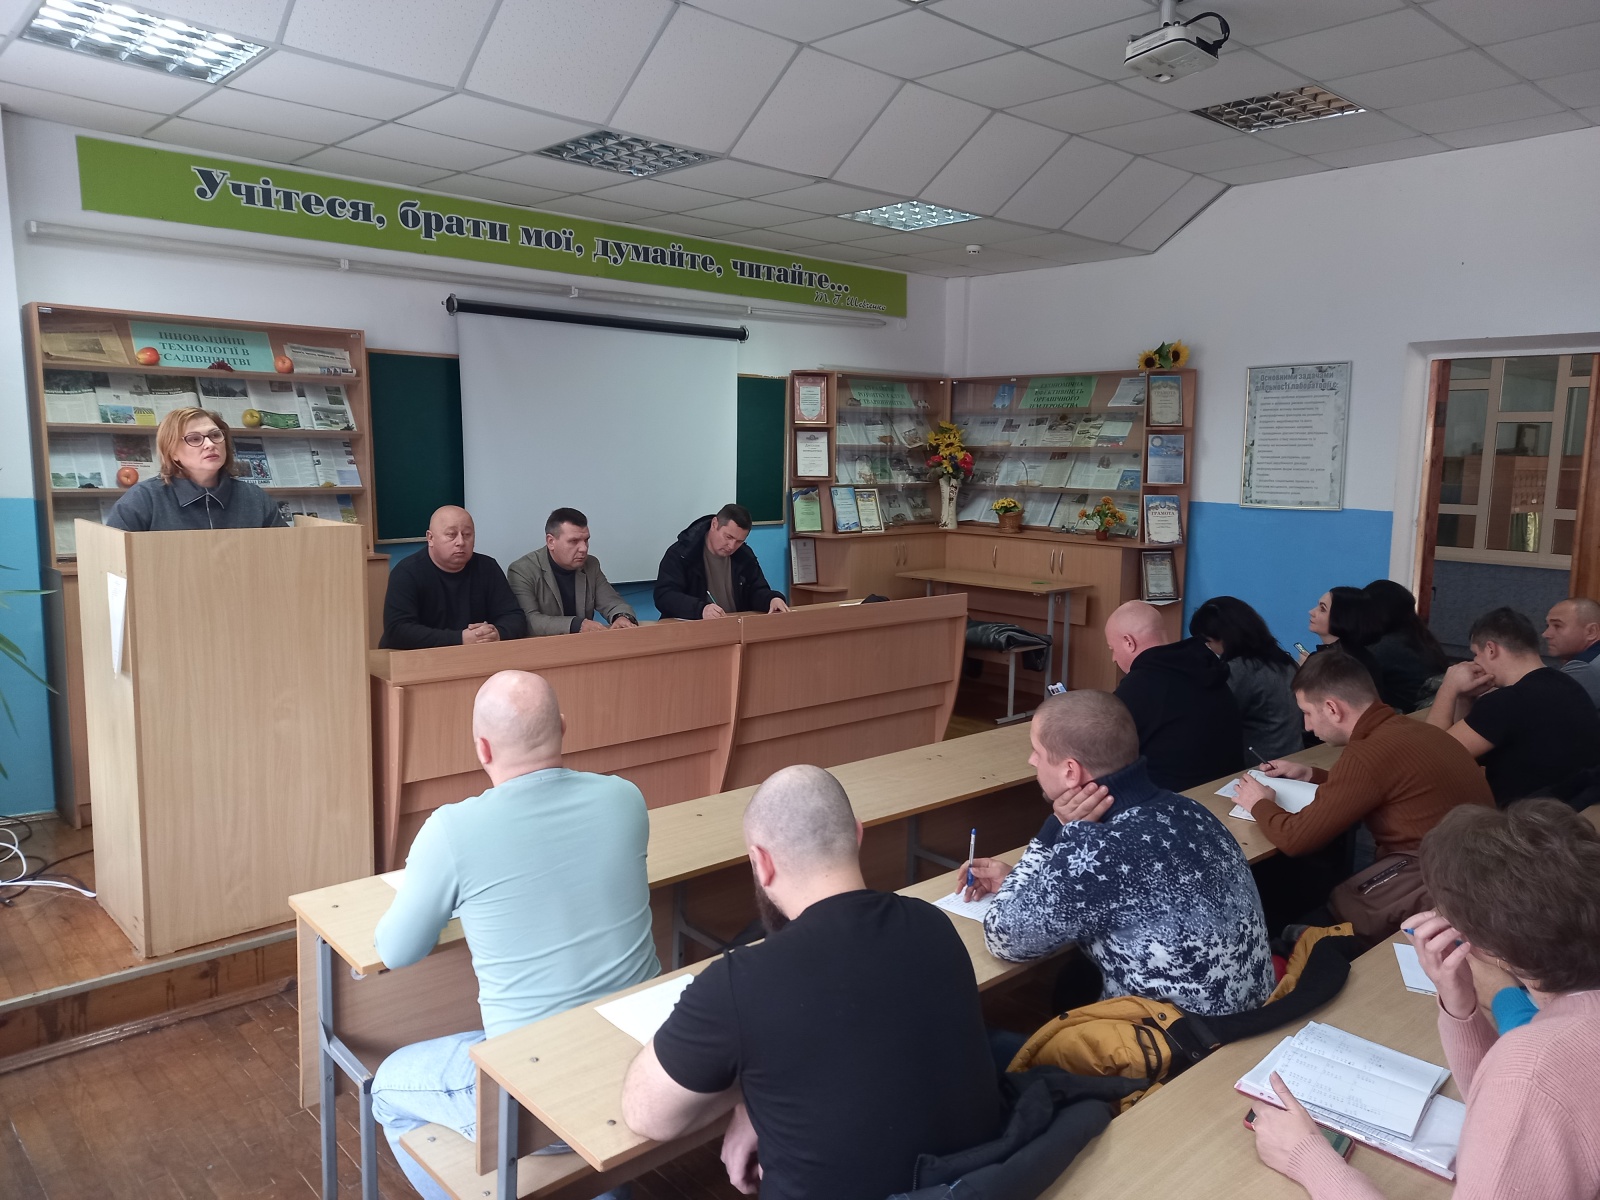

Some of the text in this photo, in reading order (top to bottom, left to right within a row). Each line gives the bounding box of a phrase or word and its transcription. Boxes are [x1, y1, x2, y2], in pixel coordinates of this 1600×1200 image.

[191, 166, 850, 293] Учітеся, брати мої, думайте, читайте...
[158, 331, 245, 346] ІННОВАЦІЙНІ
[159, 342, 250, 356] ТЕХНОЛОГІЇ В
